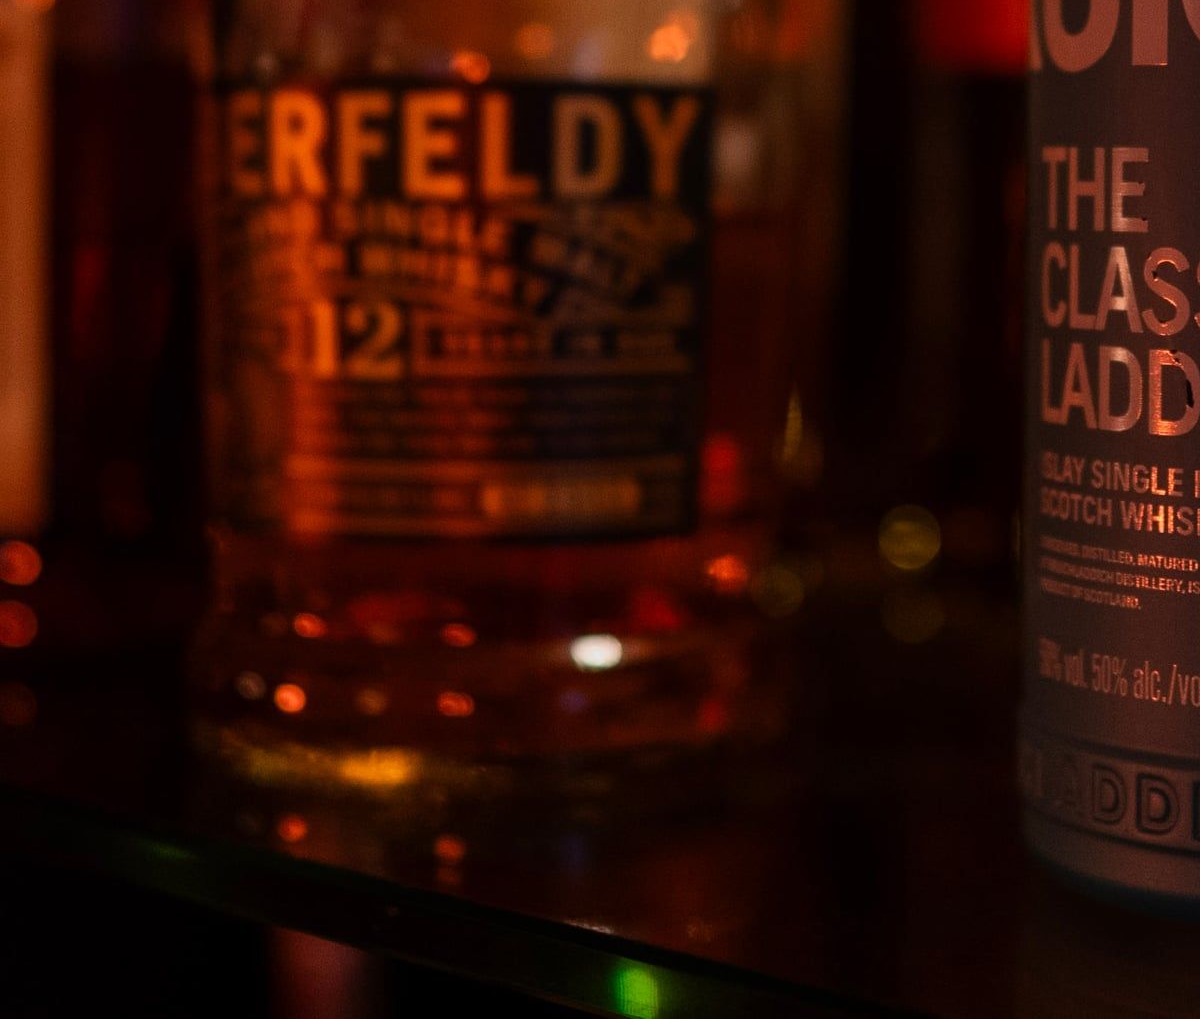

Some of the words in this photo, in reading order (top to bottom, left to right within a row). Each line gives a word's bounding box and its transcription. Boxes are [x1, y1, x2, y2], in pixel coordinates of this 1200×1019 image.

[1042, 146, 1149, 233] THE
[1091, 459, 1184, 498] SINGLE
[1137, 552, 1199, 573] MATURED
[1091, 653, 1128, 698] 50%
